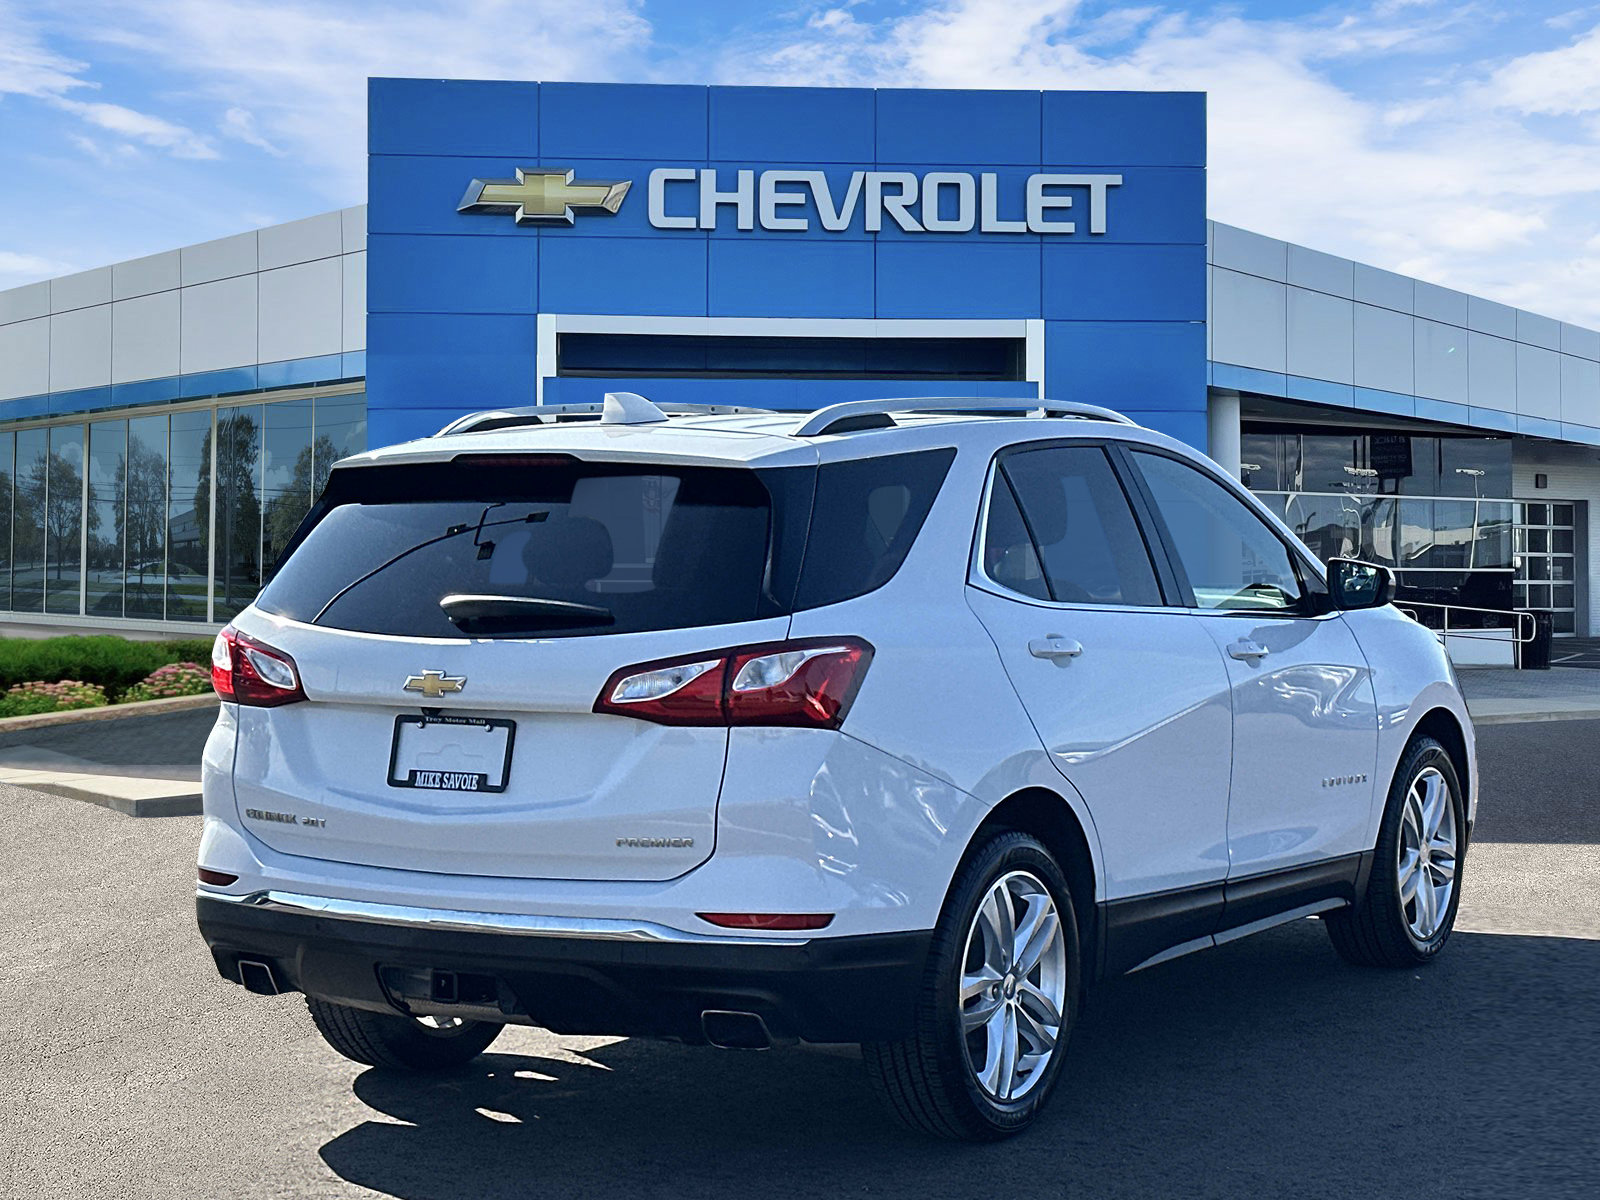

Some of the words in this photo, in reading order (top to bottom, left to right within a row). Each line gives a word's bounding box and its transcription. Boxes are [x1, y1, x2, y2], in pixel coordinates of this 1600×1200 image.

[648, 168, 1123, 234] CHEVROLET
[425, 716, 442, 724] Troy
[414, 771, 442, 789] MIKE
[442, 773, 479, 791] SAVOIE
[616, 837, 694, 848] PREMIER
